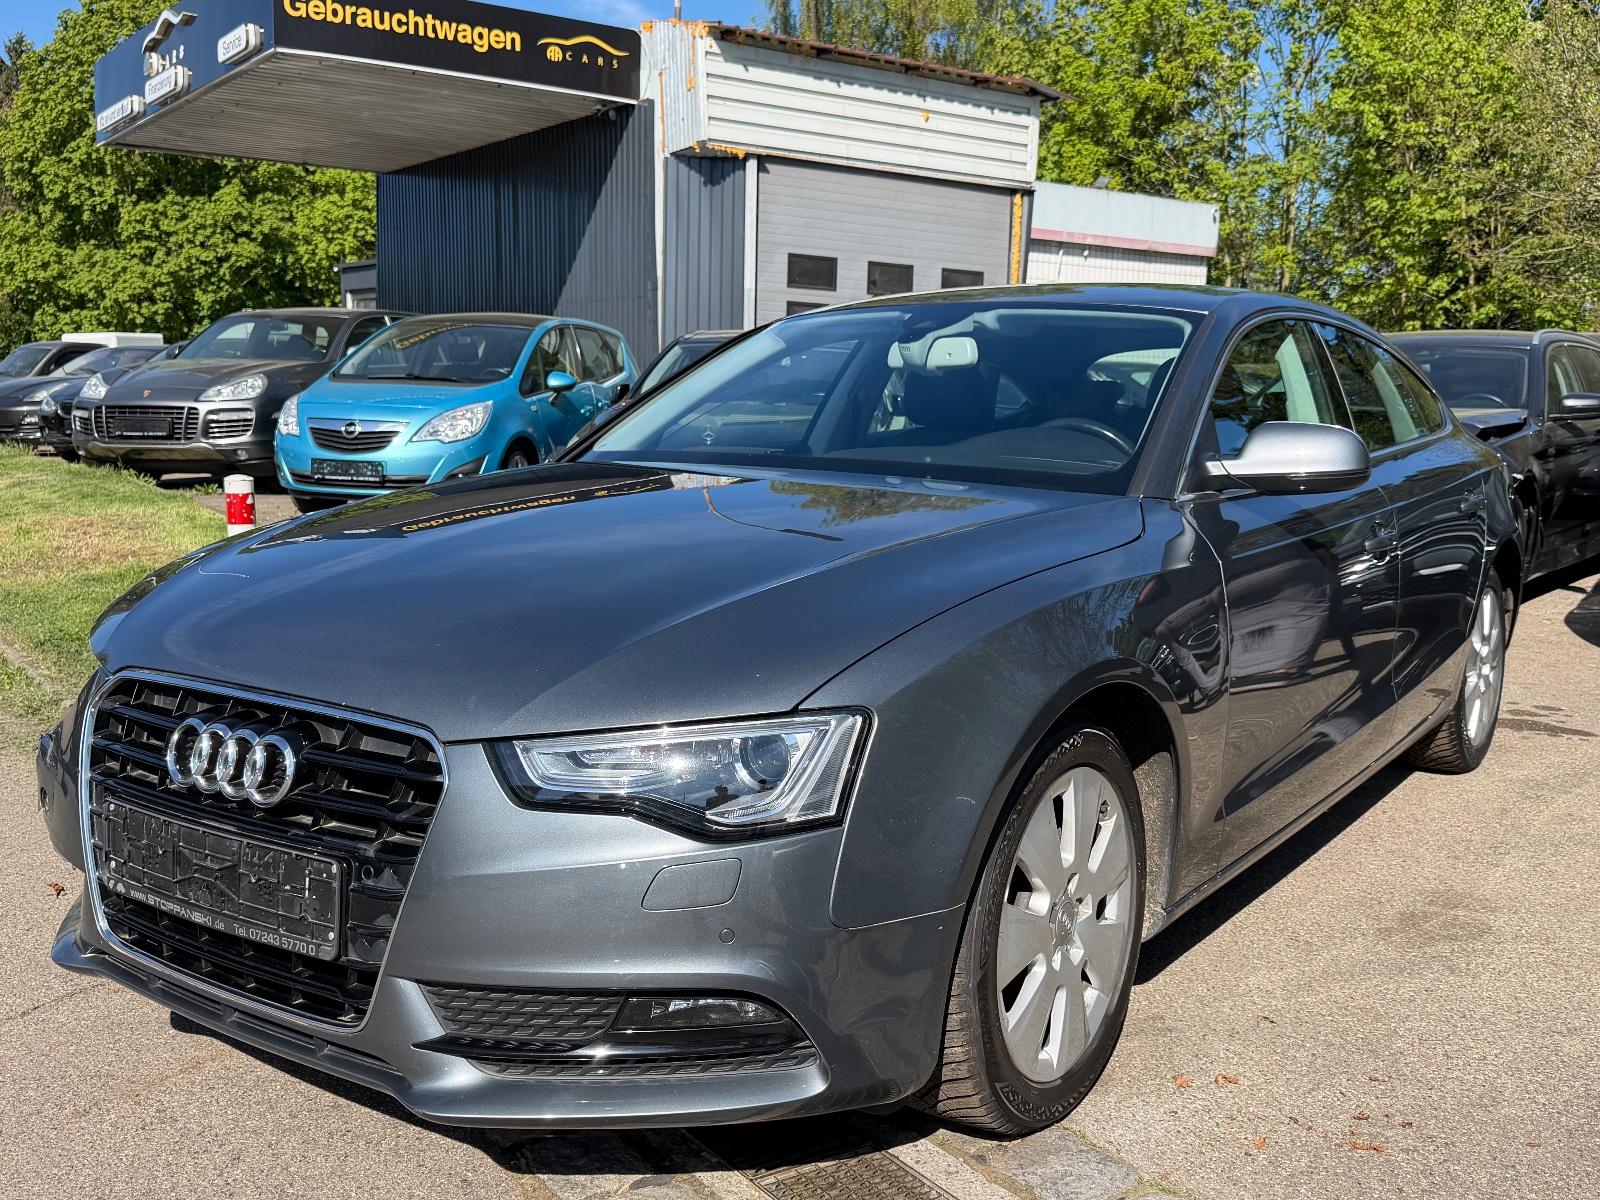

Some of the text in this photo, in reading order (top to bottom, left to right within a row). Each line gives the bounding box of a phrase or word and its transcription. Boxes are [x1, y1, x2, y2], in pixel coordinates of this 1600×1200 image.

[283, 0, 521, 52] Gebrauchtwagen
[222, 34, 242, 57] Service
[565, 51, 619, 69] CARS
[233, 923, 248, 937] Tel.
[249, 928, 280, 946] 07243
[281, 938, 307, 954] 5770
[308, 944, 316, 956] 0
